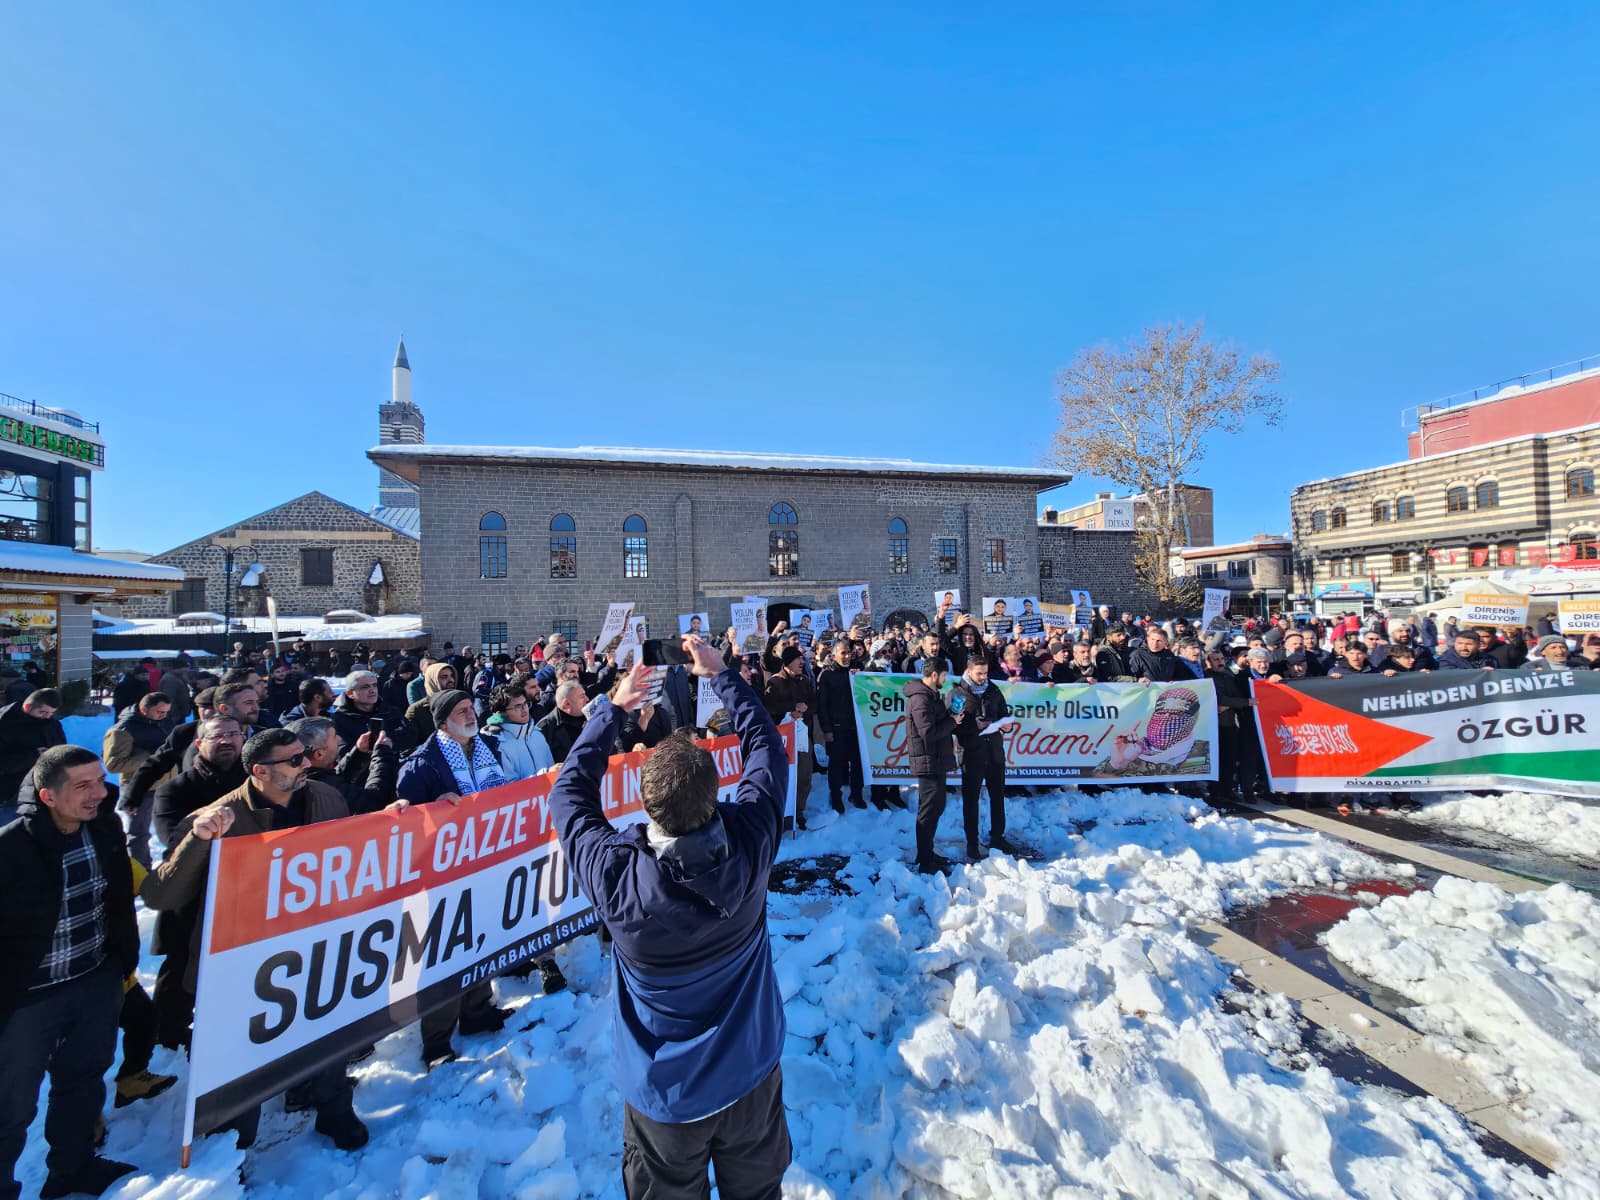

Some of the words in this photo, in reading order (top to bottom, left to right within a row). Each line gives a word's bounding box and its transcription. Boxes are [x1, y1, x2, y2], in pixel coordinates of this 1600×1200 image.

[869, 691, 905, 717] Şeh
[1064, 700, 1119, 719] Olsun
[1362, 684, 1477, 712] NEHİR'DEN
[1483, 671, 1574, 696] DENİZ'E
[1457, 709, 1587, 744] ÖZGÜR
[1020, 768, 1081, 777] KURULUŞLARI
[265, 825, 421, 920] İSRAİL
[249, 887, 486, 1045] SUSMA,
[461, 934, 551, 988] DİYARBAKIR
